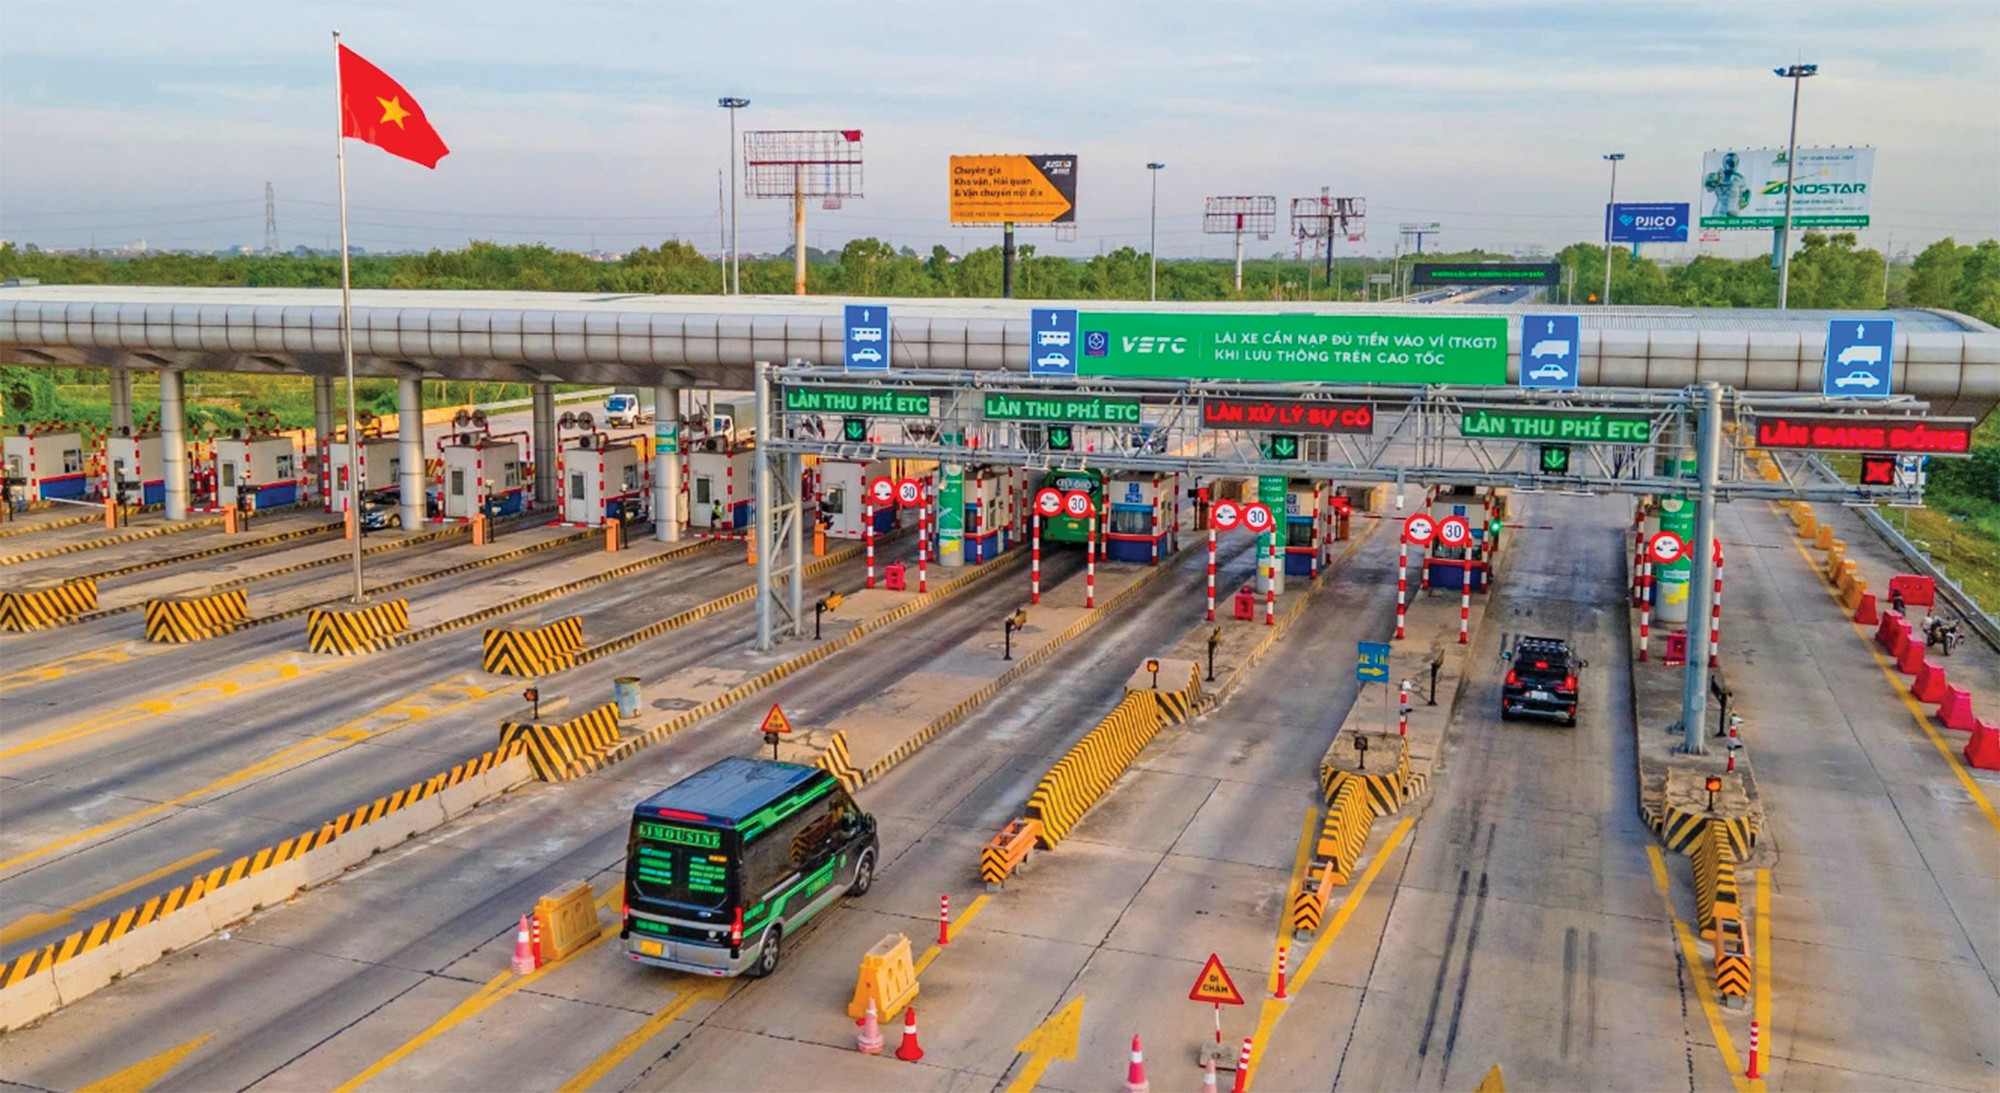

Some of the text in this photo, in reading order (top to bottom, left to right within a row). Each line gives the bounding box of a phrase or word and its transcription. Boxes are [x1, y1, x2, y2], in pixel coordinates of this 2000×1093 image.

[988, 165, 1001, 176] gia
[1761, 181, 1866, 195] DINOSTAR
[1635, 216, 1676, 227] PJICO
[1122, 336, 1188, 354] VETC
[1241, 333, 1258, 344] XE
[1297, 334, 1328, 349] NẠP
[1331, 331, 1352, 346] ĐỦ
[1429, 333, 1445, 347] VÍ
[1448, 336, 1497, 349] (TKGT)
[1215, 348, 1445, 365] KHI LƯU THÔNG TRÊN CAO TỐC
[788, 388, 928, 413] LÀN THU PHÍ ETC
[987, 396, 1138, 420] LÀN THU PHÍ ETC
[1206, 401, 1243, 422] LÀN
[1247, 402, 1277, 423] XỬ
[1279, 403, 1305, 424] LÝ
[1307, 408, 1338, 429] SỰ
[1464, 411, 1648, 440] LÀN THU PHÍ ETC
[1760, 420, 1968, 450] LÀN ĐANG ĐÓNG
[903, 486, 915, 499] 30
[1071, 498, 1085, 511] 30
[1250, 510, 1265, 523] 30
[1445, 525, 1462, 538] 30
[639, 824, 720, 847] LIMOUSINE
